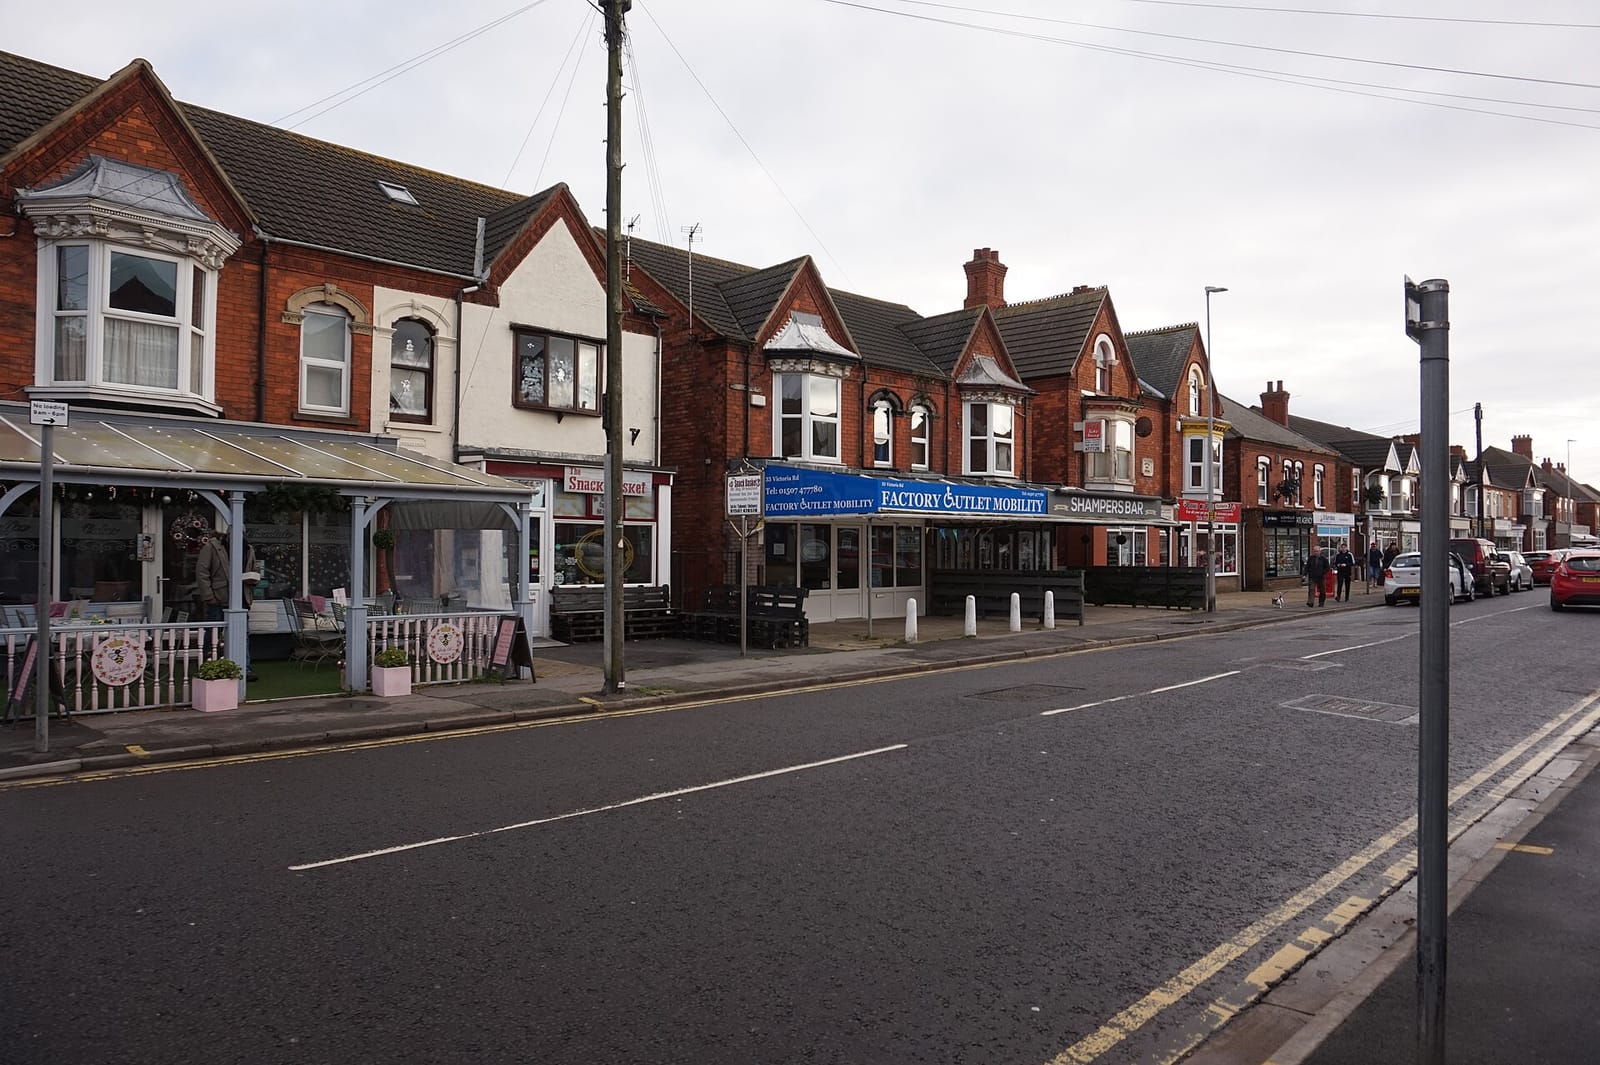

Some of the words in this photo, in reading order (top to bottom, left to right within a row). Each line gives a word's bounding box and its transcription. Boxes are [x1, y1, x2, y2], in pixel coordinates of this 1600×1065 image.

[43, 403, 65, 411] loading
[570, 467, 581, 476] The
[622, 481, 646, 494] sket
[765, 487, 778, 495] Tel:
[798, 485, 823, 495] 477780
[765, 502, 799, 511] FACTORY
[833, 499, 874, 509] MOBILITY
[881, 490, 942, 508] FACTORY
[993, 497, 1044, 513] MOBILITY
[1071, 496, 1125, 514] SHAMPERS
[1125, 500, 1144, 515] BAR
